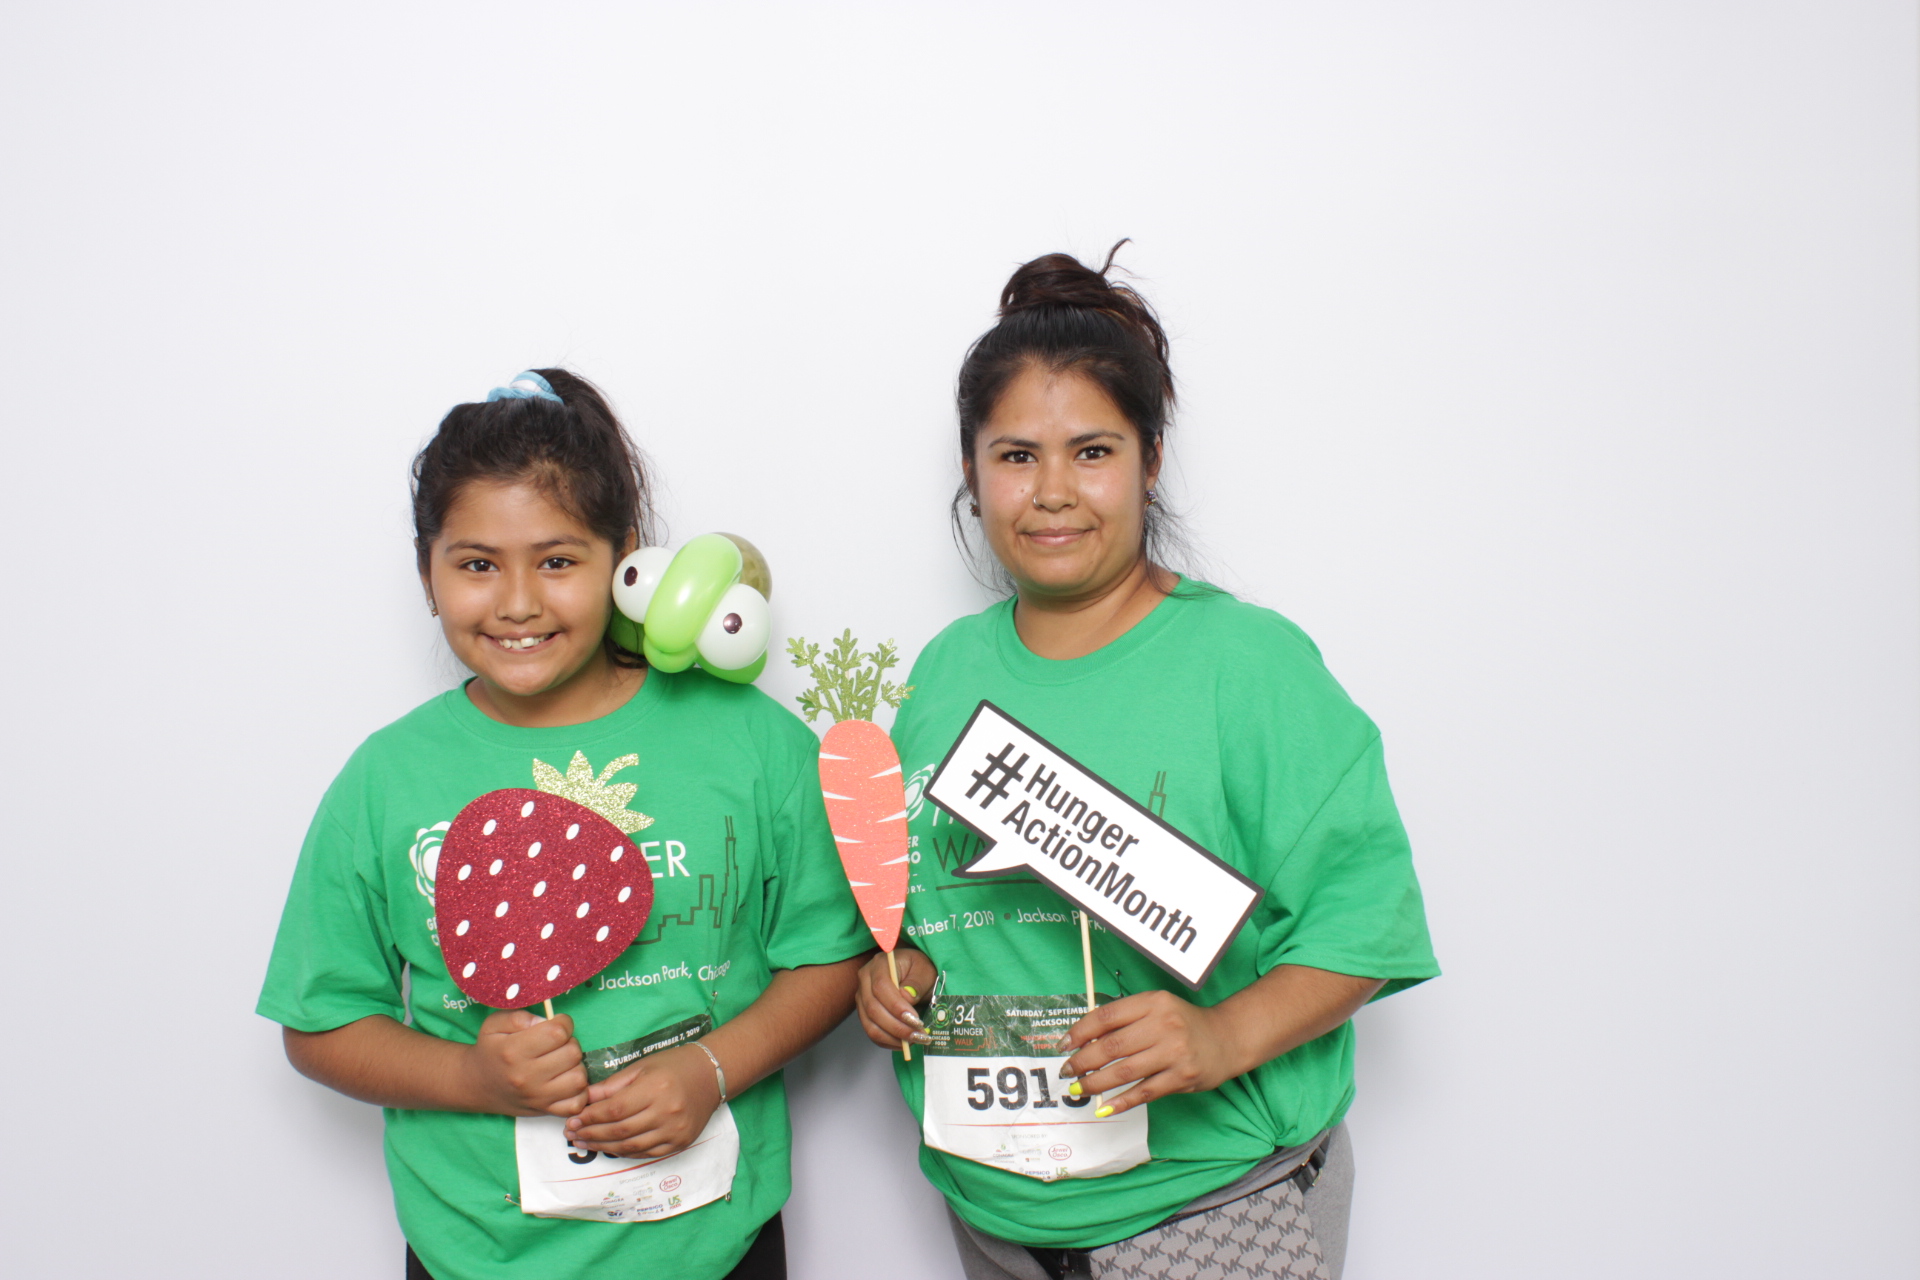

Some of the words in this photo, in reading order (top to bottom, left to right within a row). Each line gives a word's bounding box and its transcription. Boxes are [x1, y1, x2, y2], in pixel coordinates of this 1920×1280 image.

[1001, 800, 1197, 954] ActionMonth
[907, 918, 948, 937] ember
[963, 911, 995, 929] 2019
[1017, 907, 1067, 923] Jackson
[598, 970, 661, 991] Jackson
[661, 961, 693, 982] Park,
[698, 960, 730, 982] Chicago
[954, 1004, 976, 1025] 34
[1006, 1009, 1046, 1018] SATURDAY,
[1048, 1006, 1088, 1016] SEPTEMBE
[953, 1027, 983, 1037] HUNGER
[1031, 1018, 1069, 1027] JACKSON
[604, 1050, 642, 1069] SATURDAY,
[643, 1036, 679, 1055] SEPTEMBER
[686, 1026, 700, 1038] 2019
[954, 1038, 974, 1047] WALK
[1246, 1191, 1269, 1208] MK
[1271, 1193, 1293, 1213] MK
[1204, 1207, 1228, 1224] MK
[1229, 1209, 1254, 1229] MK
[1254, 1213, 1277, 1233] MK
[1160, 1222, 1184, 1240] MK
[1186, 1226, 1211, 1246] MK
[1278, 1218, 1302, 1237] MK
[1115, 1238, 1139, 1255] MK
[1212, 1230, 1237, 1250] MK
[1238, 1234, 1261, 1254] MK
[1262, 1238, 1286, 1258] MK
[1140, 1241, 1166, 1261] MK
[1167, 1246, 1193, 1266] MK
[1195, 1251, 1219, 1271] MK
[1288, 1242, 1312, 1262] MK
[1098, 1256, 1120, 1274] MK
[1221, 1255, 1245, 1276] MK
